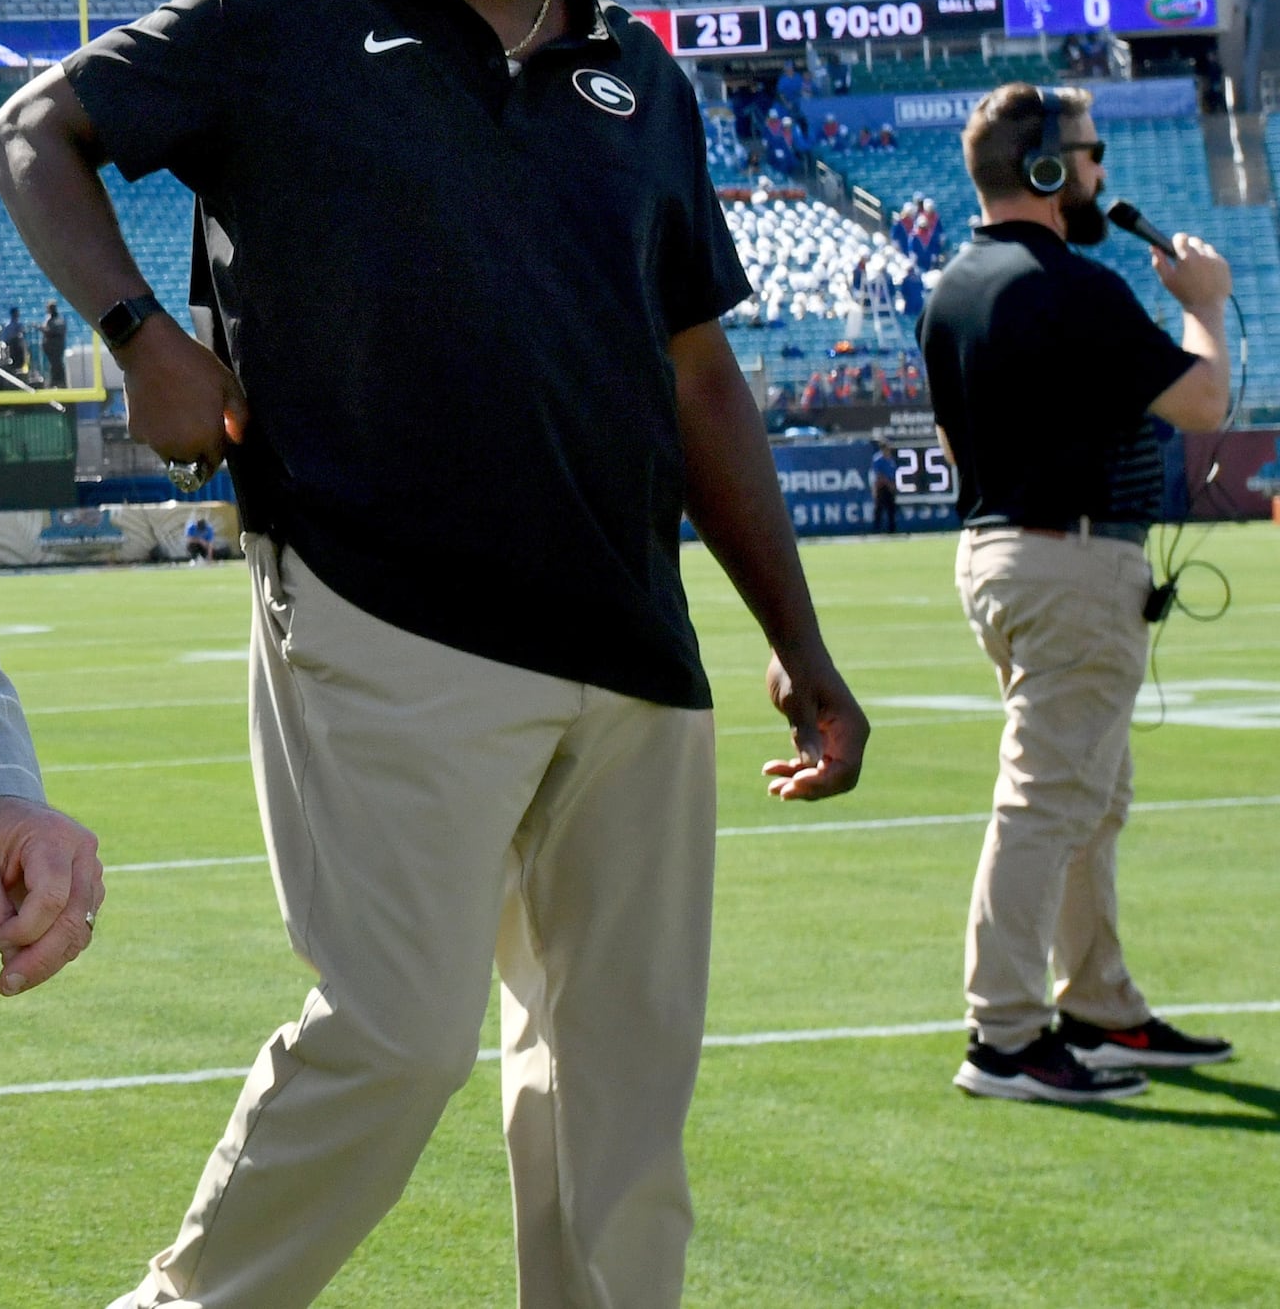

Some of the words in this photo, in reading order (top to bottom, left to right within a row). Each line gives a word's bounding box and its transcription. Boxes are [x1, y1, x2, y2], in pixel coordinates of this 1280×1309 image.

[695, 13, 742, 47] 25
[776, 9, 817, 40] Q1
[825, 2, 923, 39] 90:00
[777, 469, 865, 493] ORIDA
[894, 448, 950, 493] 25
